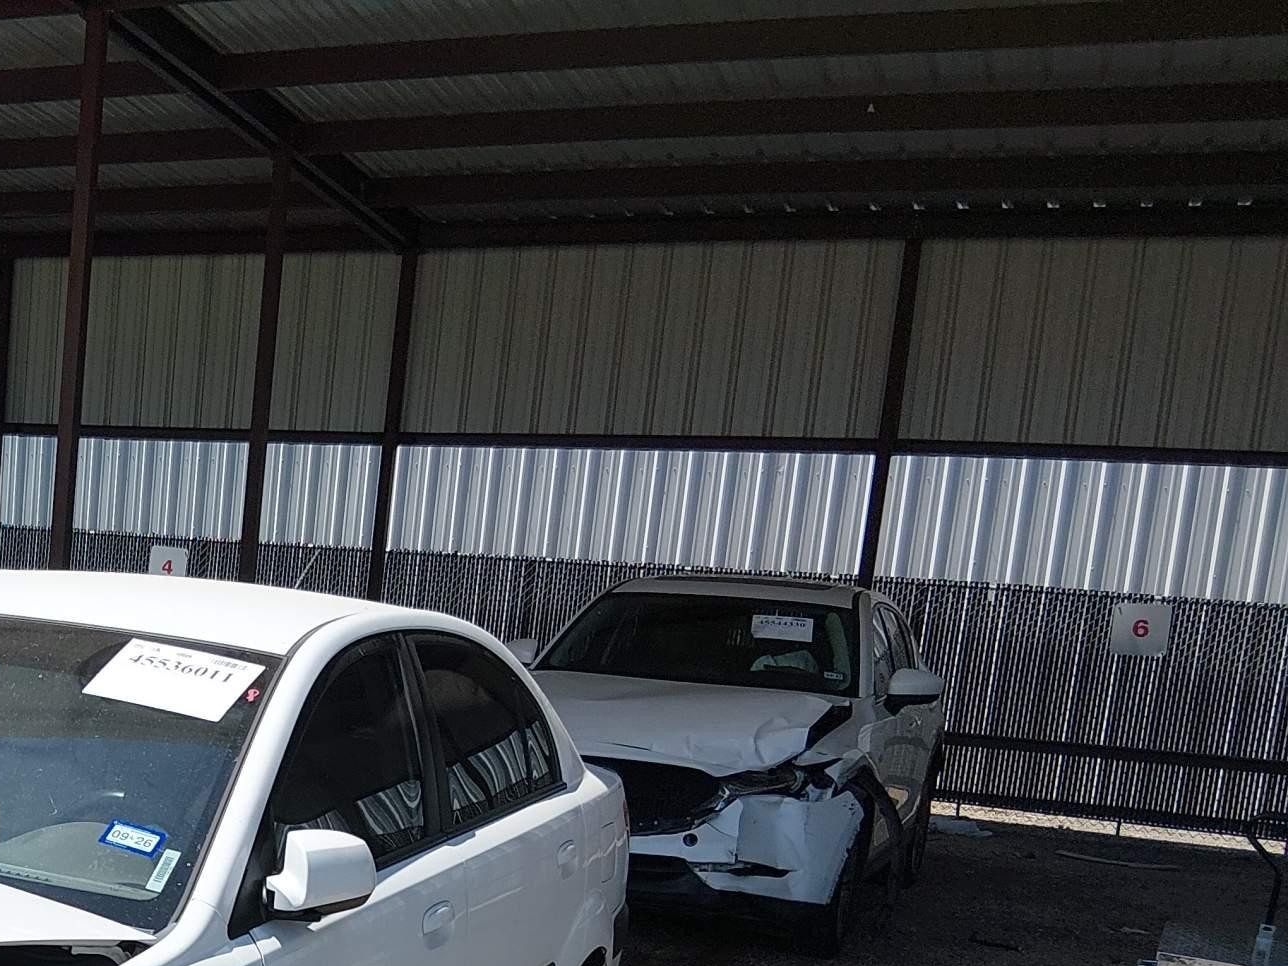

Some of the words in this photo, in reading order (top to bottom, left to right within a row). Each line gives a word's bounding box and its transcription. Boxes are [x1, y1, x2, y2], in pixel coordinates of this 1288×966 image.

[161, 559, 173, 575] 4
[1132, 619, 1149, 638] 6
[129, 654, 234, 683] 45536011
